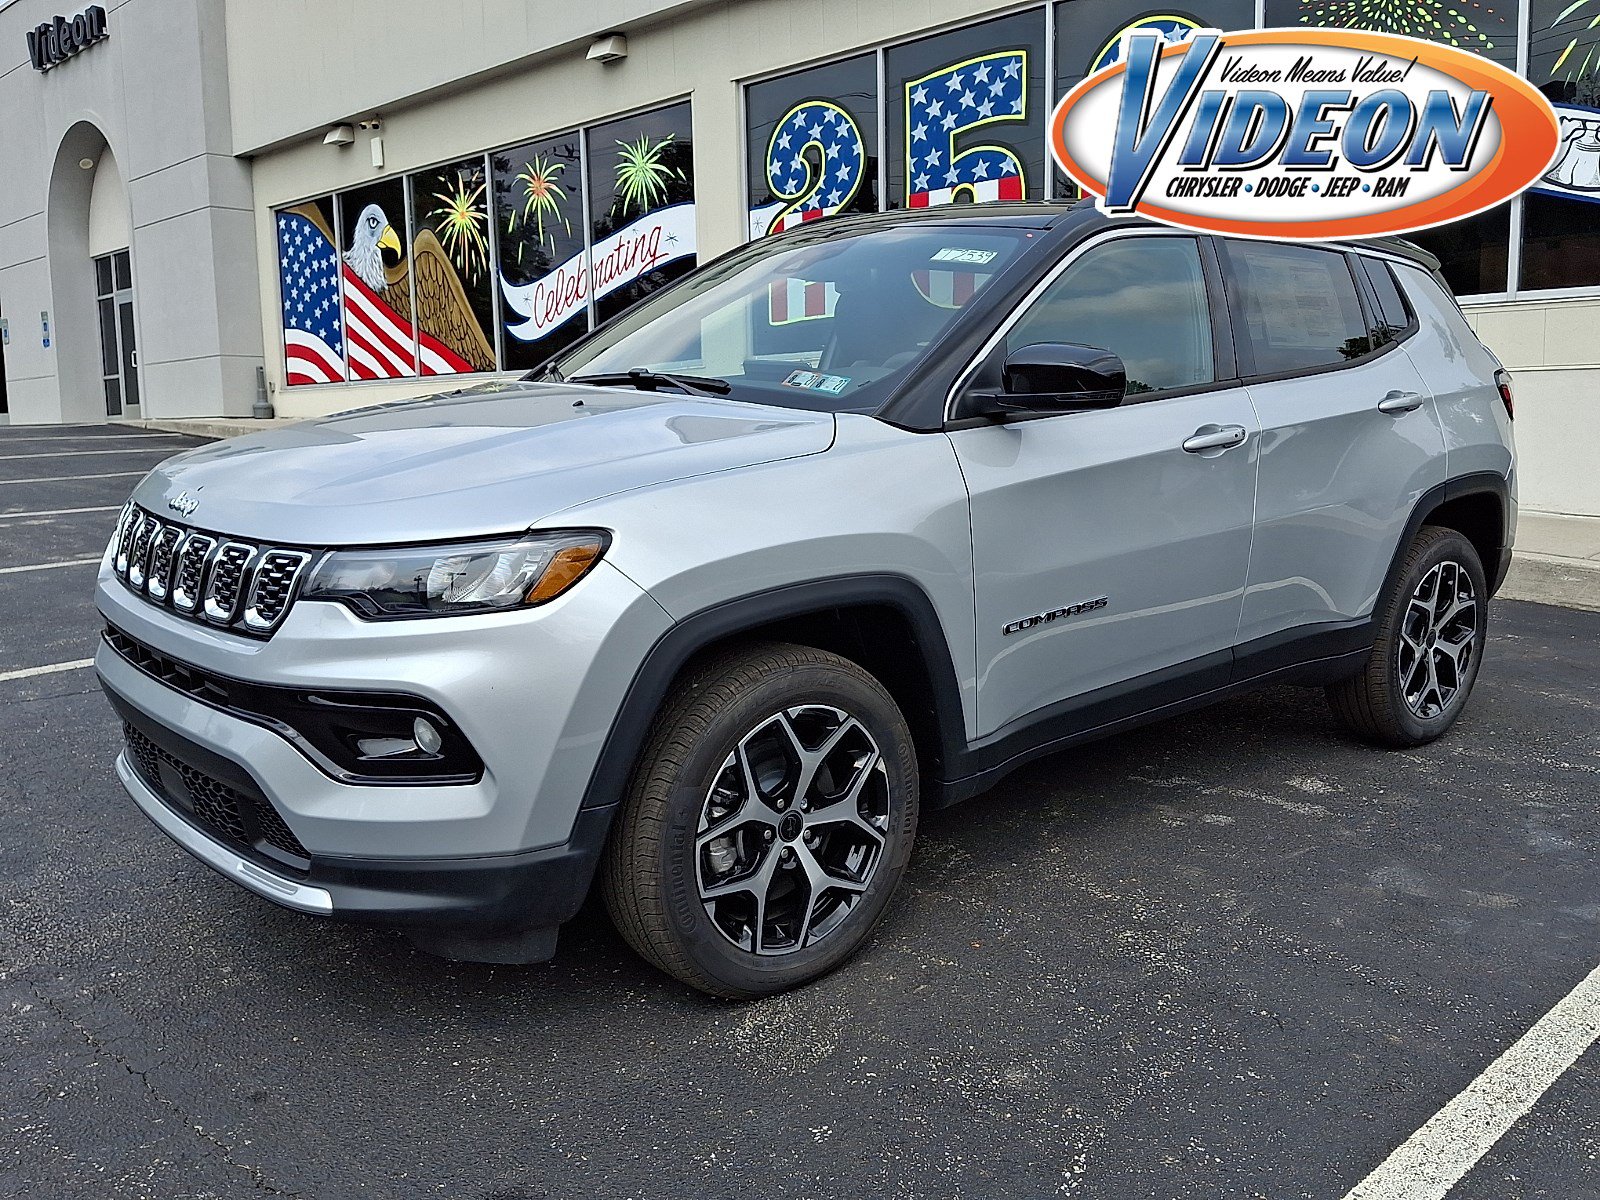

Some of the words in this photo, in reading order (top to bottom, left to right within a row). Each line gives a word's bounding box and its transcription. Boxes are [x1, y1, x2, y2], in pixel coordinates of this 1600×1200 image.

[26, 5, 107, 70] Videon
[534, 226, 669, 329] Celebrating
[169, 490, 200, 518] Jeep
[1002, 595, 1108, 635] COMPASS
